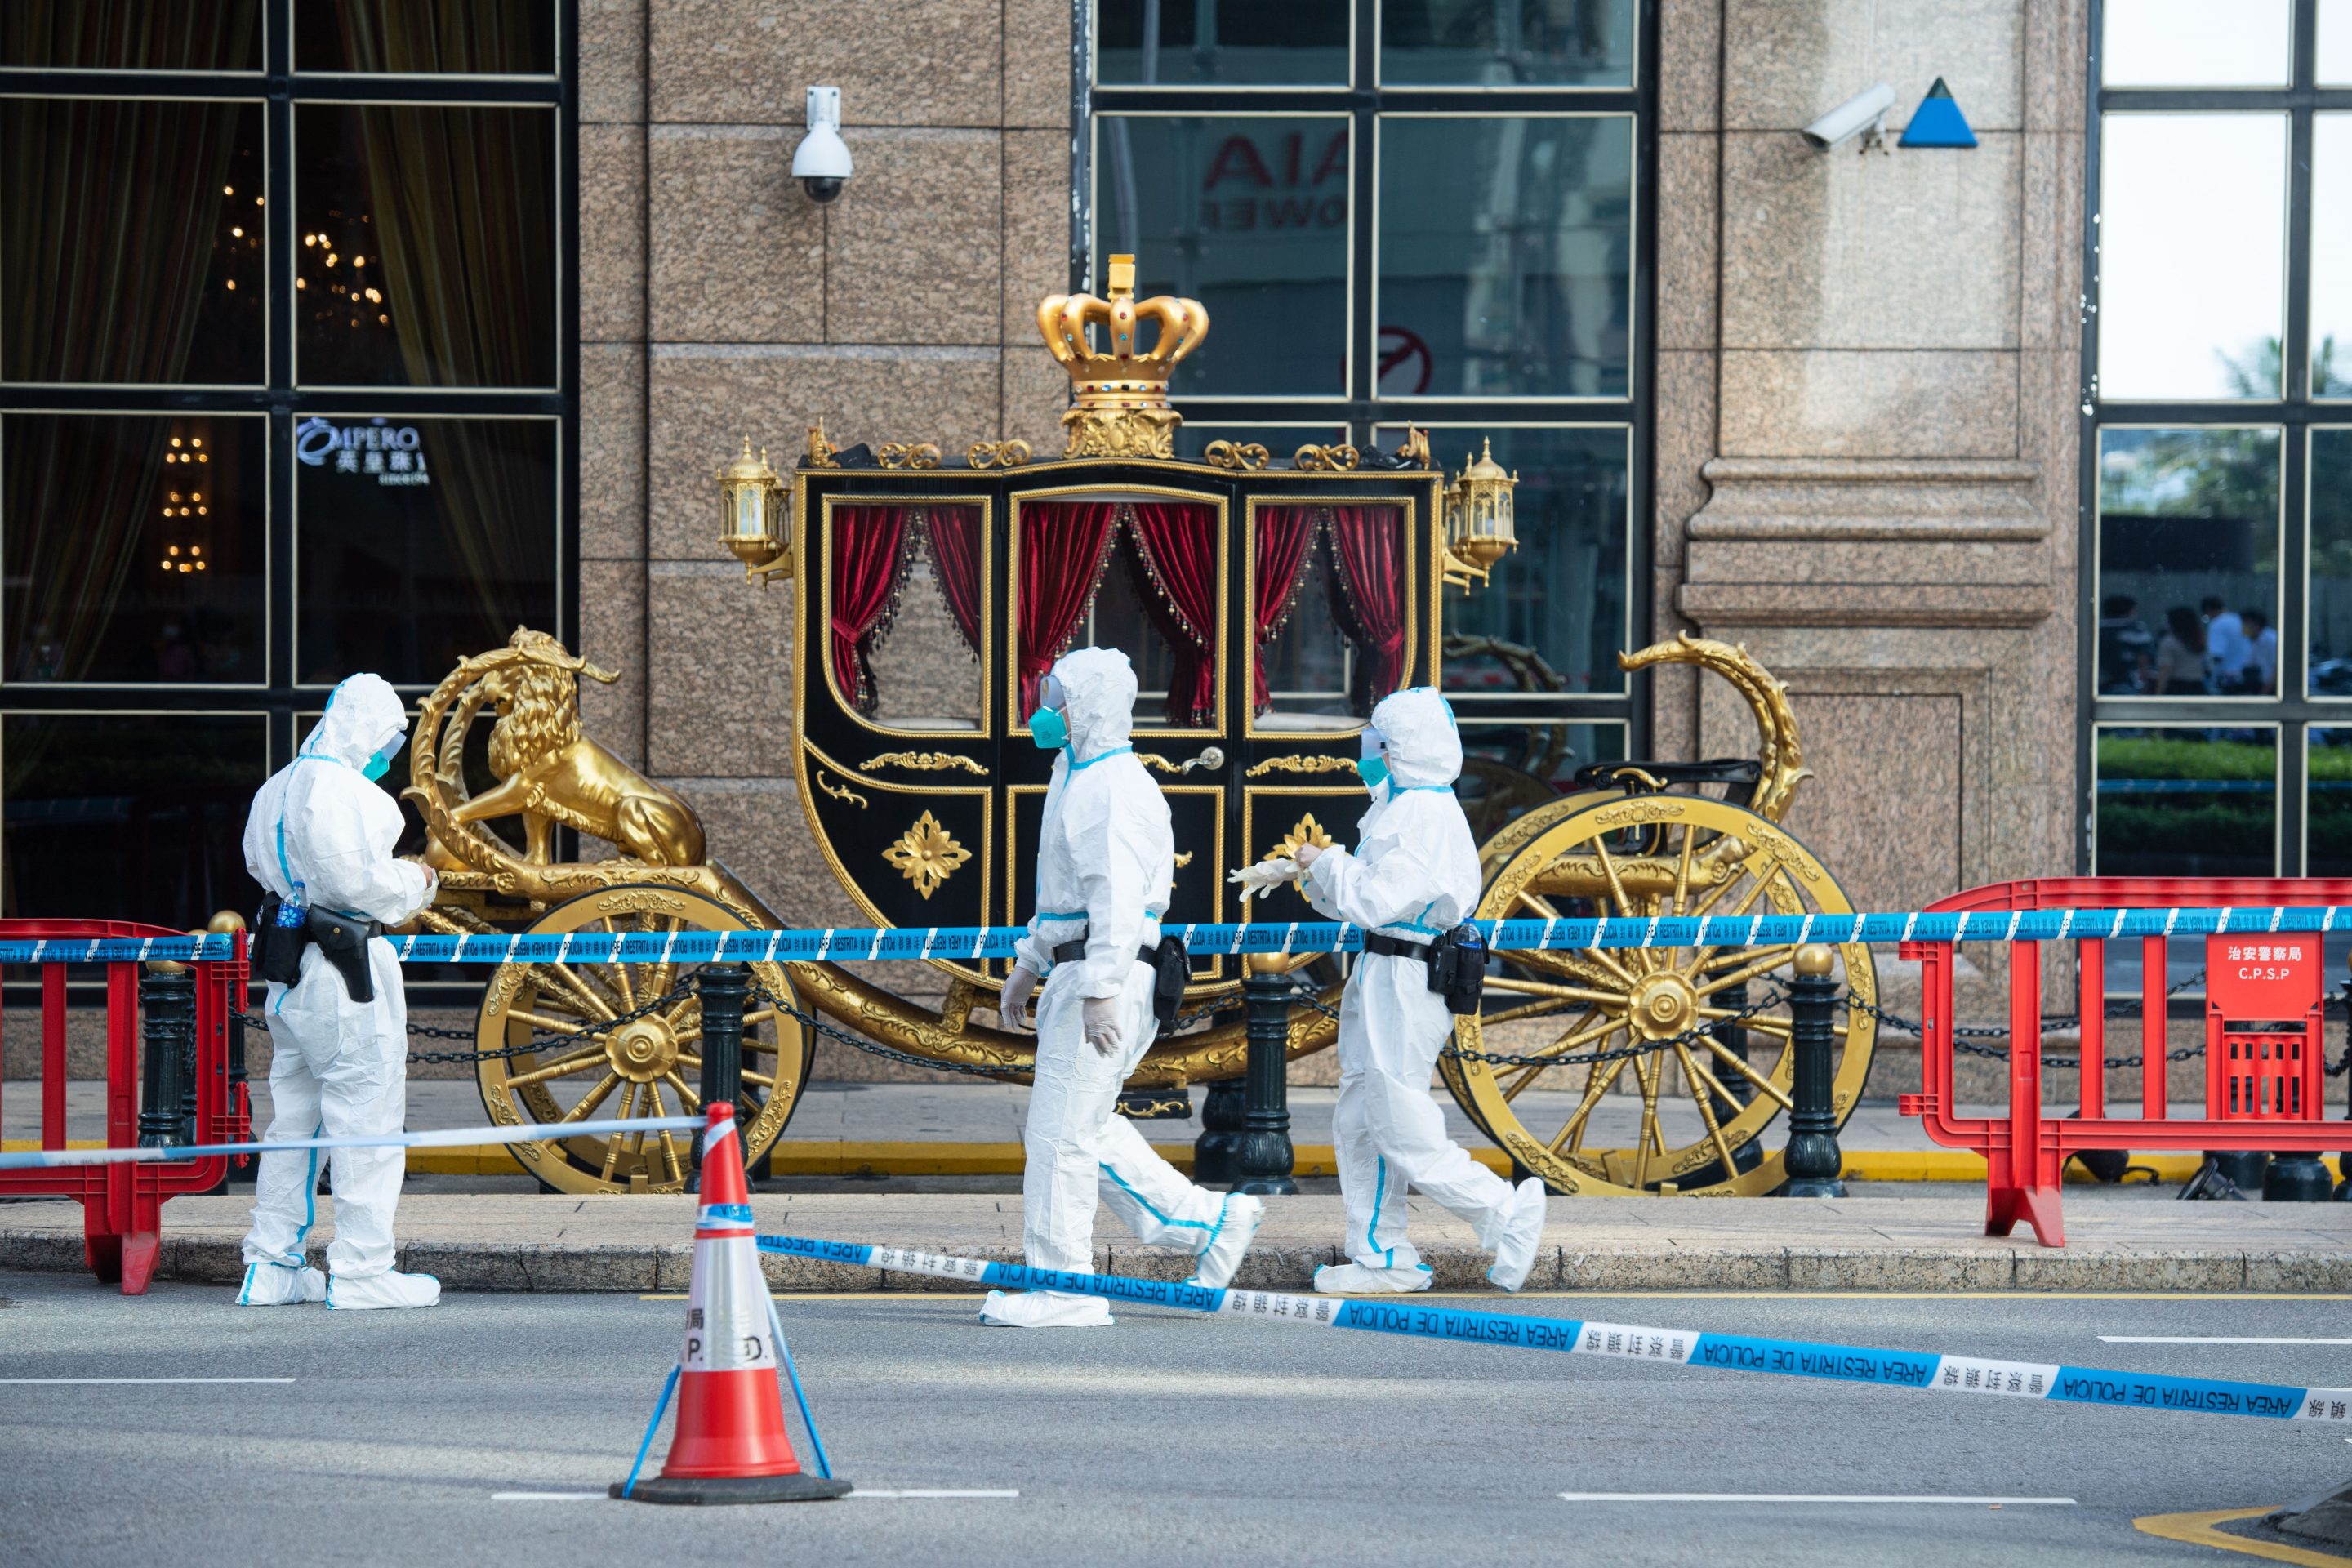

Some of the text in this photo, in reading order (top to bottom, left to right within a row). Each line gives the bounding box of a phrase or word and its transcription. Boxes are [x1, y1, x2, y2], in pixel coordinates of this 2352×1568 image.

[1542, 925, 1565, 938] RESTRITA
[1659, 924, 1683, 938] RESTRITA
[1748, 923, 1772, 936] RESTRITA
[1867, 921, 1890, 934] RESTRITA
[1955, 920, 1980, 933] RESTRITA
[834, 936, 858, 950] RESTRITA
[923, 935, 947, 948] RESTRITA
[1248, 931, 1271, 944] RESTRITA
[1336, 929, 1359, 943] RESTRITA
[416, 943, 439, 956] RESTRITA
[506, 942, 530, 956] RESTRITA
[626, 940, 650, 953] RESTRITA
[715, 938, 738, 952] RESTRITA
[2228, 946, 2301, 961] 治安警察局
[2238, 968, 2290, 980] C.P.S.P
[999, 1265, 1057, 1287] POLÍCIA
[1065, 1274, 1085, 1290] DE
[1093, 1275, 1166, 1302] RESTRITA
[1232, 1290, 1330, 1322] 警察封鎖線
[687, 1309, 704, 1330] 局
[1350, 1303, 1410, 1330] POLÍCIA
[1416, 1312, 1439, 1334] DE
[1445, 1315, 1519, 1343] RESTRITA
[1586, 1329, 1685, 1360] 警察封鎖線
[1704, 1343, 1765, 1368] POLÍCIA
[1772, 1350, 1794, 1370] DE
[1801, 1352, 1877, 1379] RESTRITA
[1944, 1365, 2043, 1394] 警察封鎖線
[2063, 1378, 2125, 1402] POLÍCIA
[2133, 1384, 2156, 1405] DE
[2162, 1387, 2240, 1411] RESTRITA
